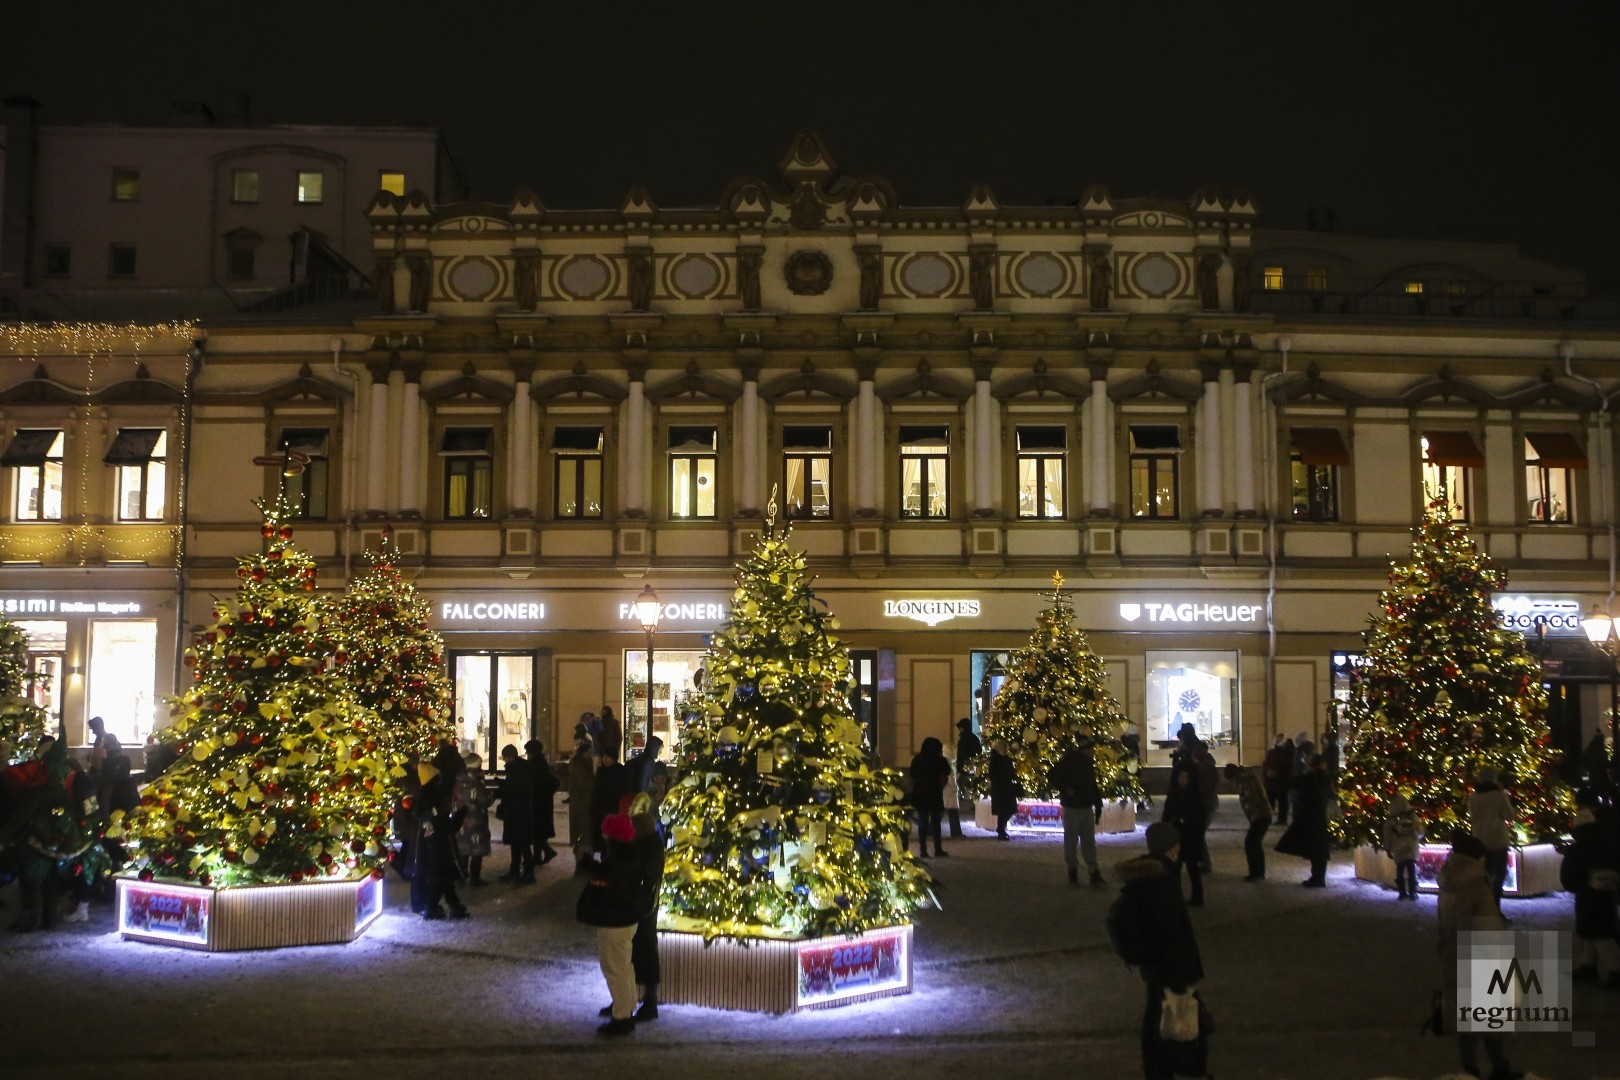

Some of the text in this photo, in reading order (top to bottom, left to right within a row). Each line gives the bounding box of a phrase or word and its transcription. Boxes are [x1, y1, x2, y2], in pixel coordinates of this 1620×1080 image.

[443, 603, 545, 619] FALCONERI
[619, 603, 723, 619] FAONERI
[887, 602, 979, 614] LONGINES
[1031, 806, 1059, 817] 2022
[149, 894, 182, 913] 2022
[831, 944, 873, 968] 2022
